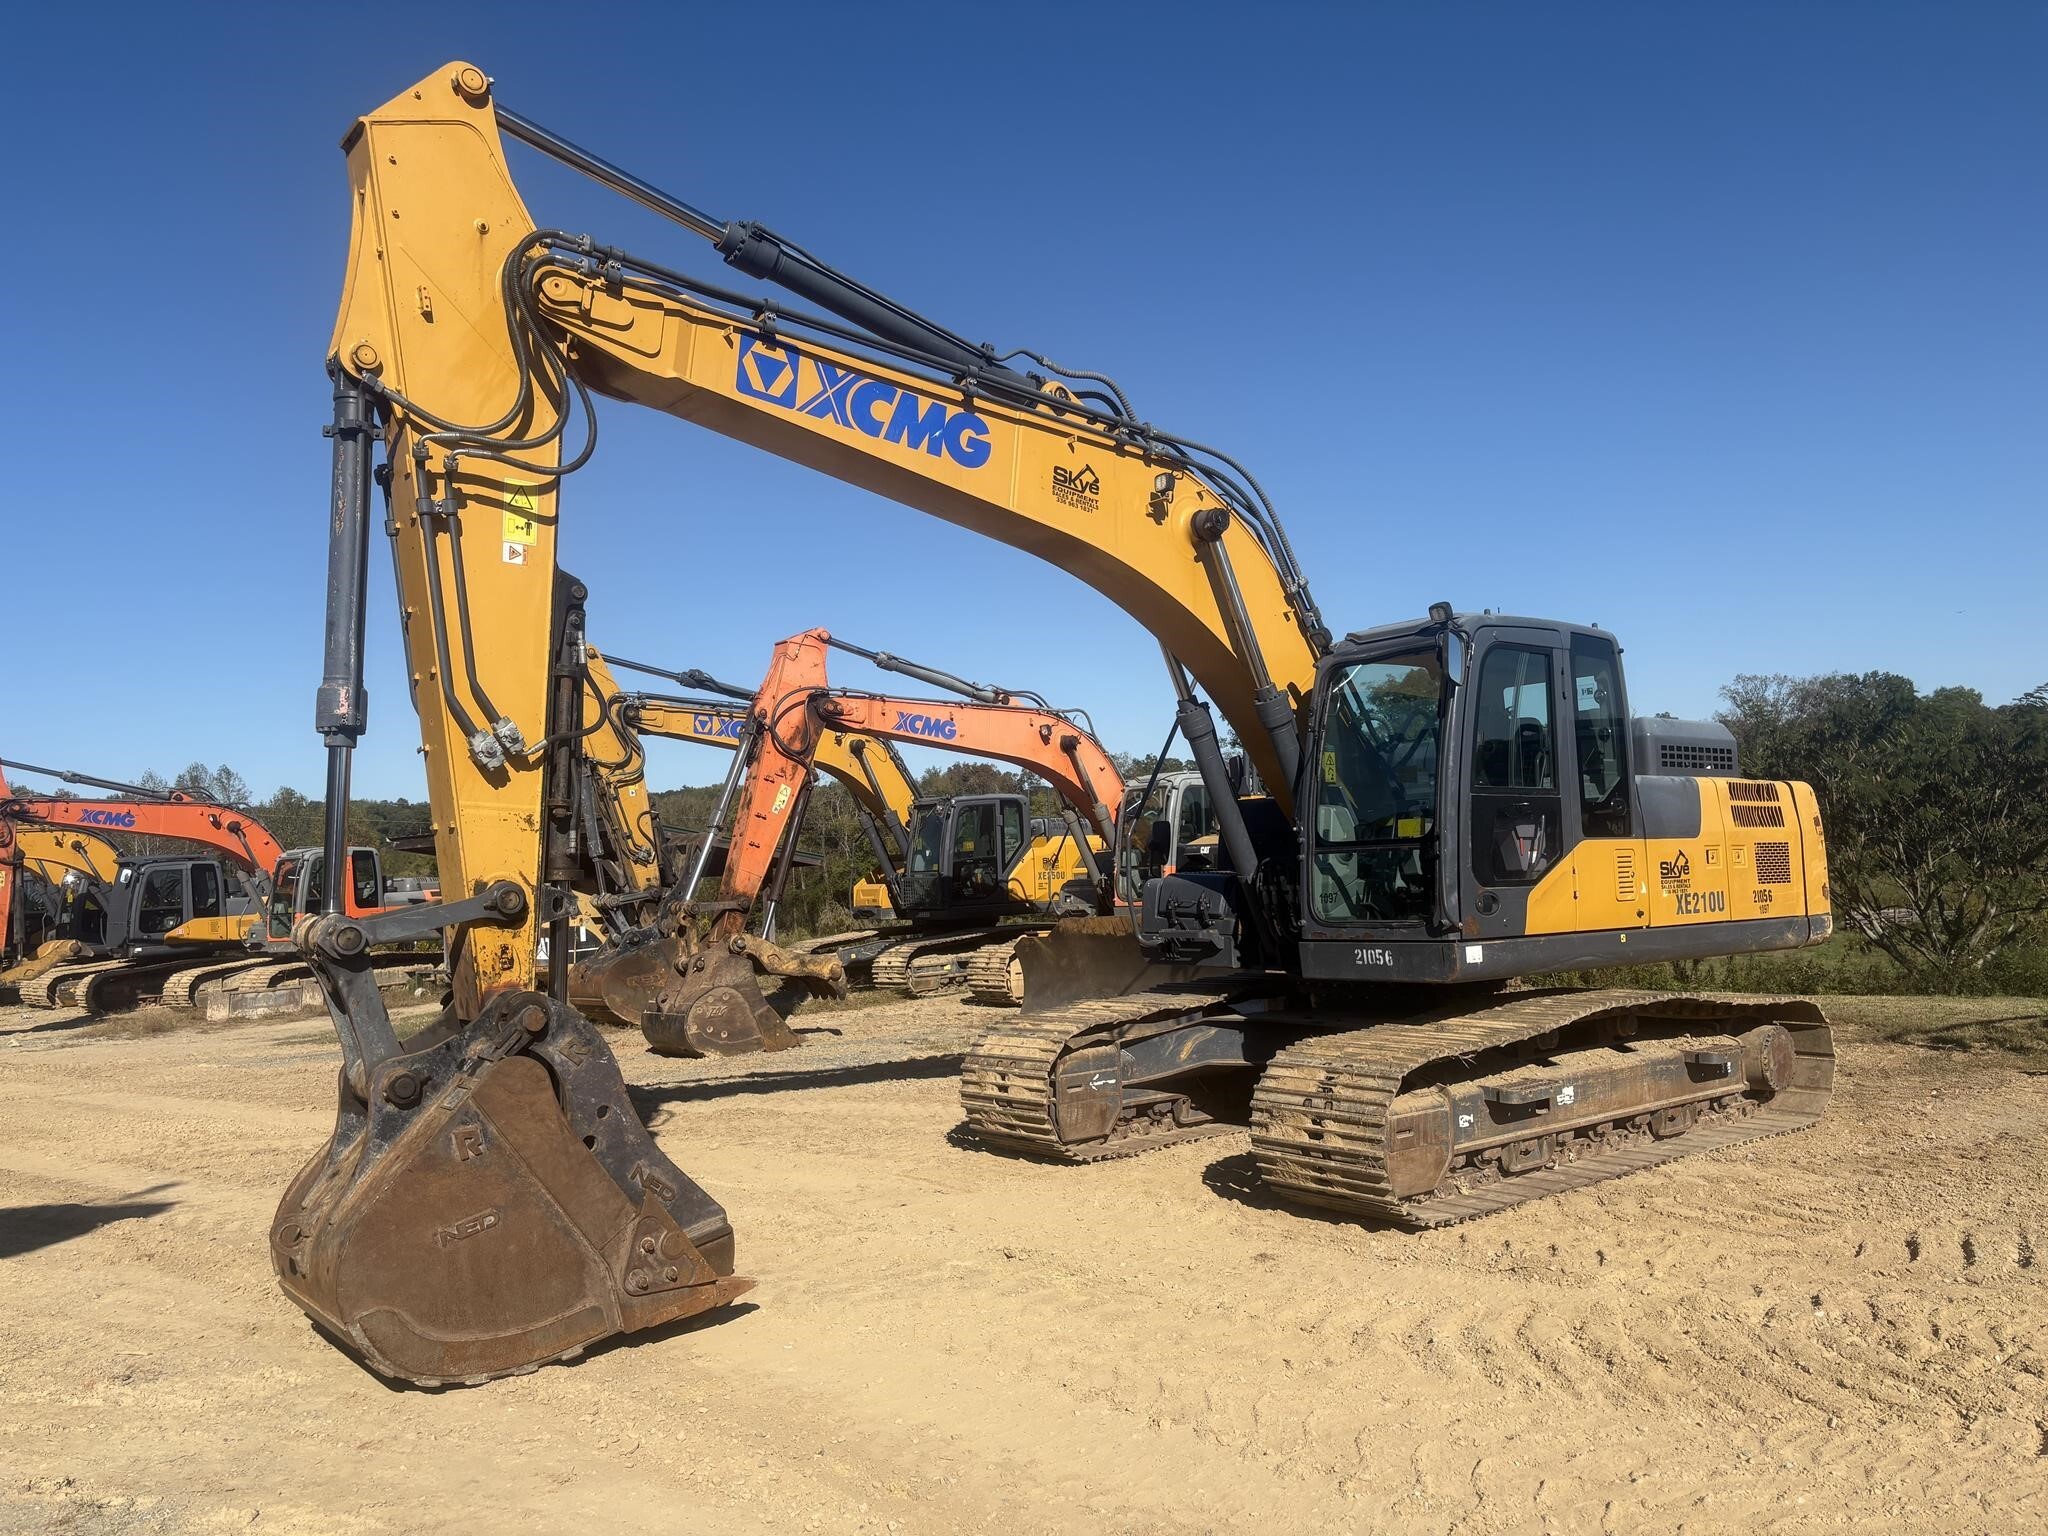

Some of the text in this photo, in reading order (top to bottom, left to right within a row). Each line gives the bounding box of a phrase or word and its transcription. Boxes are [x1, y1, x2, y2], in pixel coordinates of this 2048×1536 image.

[797, 359, 992, 469] XCMG
[1053, 464, 1099, 495] Skye
[1052, 485, 1099, 505] EQUIPMENT
[891, 711, 957, 740] XCMG
[78, 809, 136, 828] XCMG
[1660, 849, 1690, 879] Skye
[1319, 892, 1338, 904] 1097
[1676, 890, 1725, 915] XE210U
[1752, 889, 1773, 903] 21056
[1354, 949, 1394, 966] 21056
[452, 1126, 484, 1161] R
